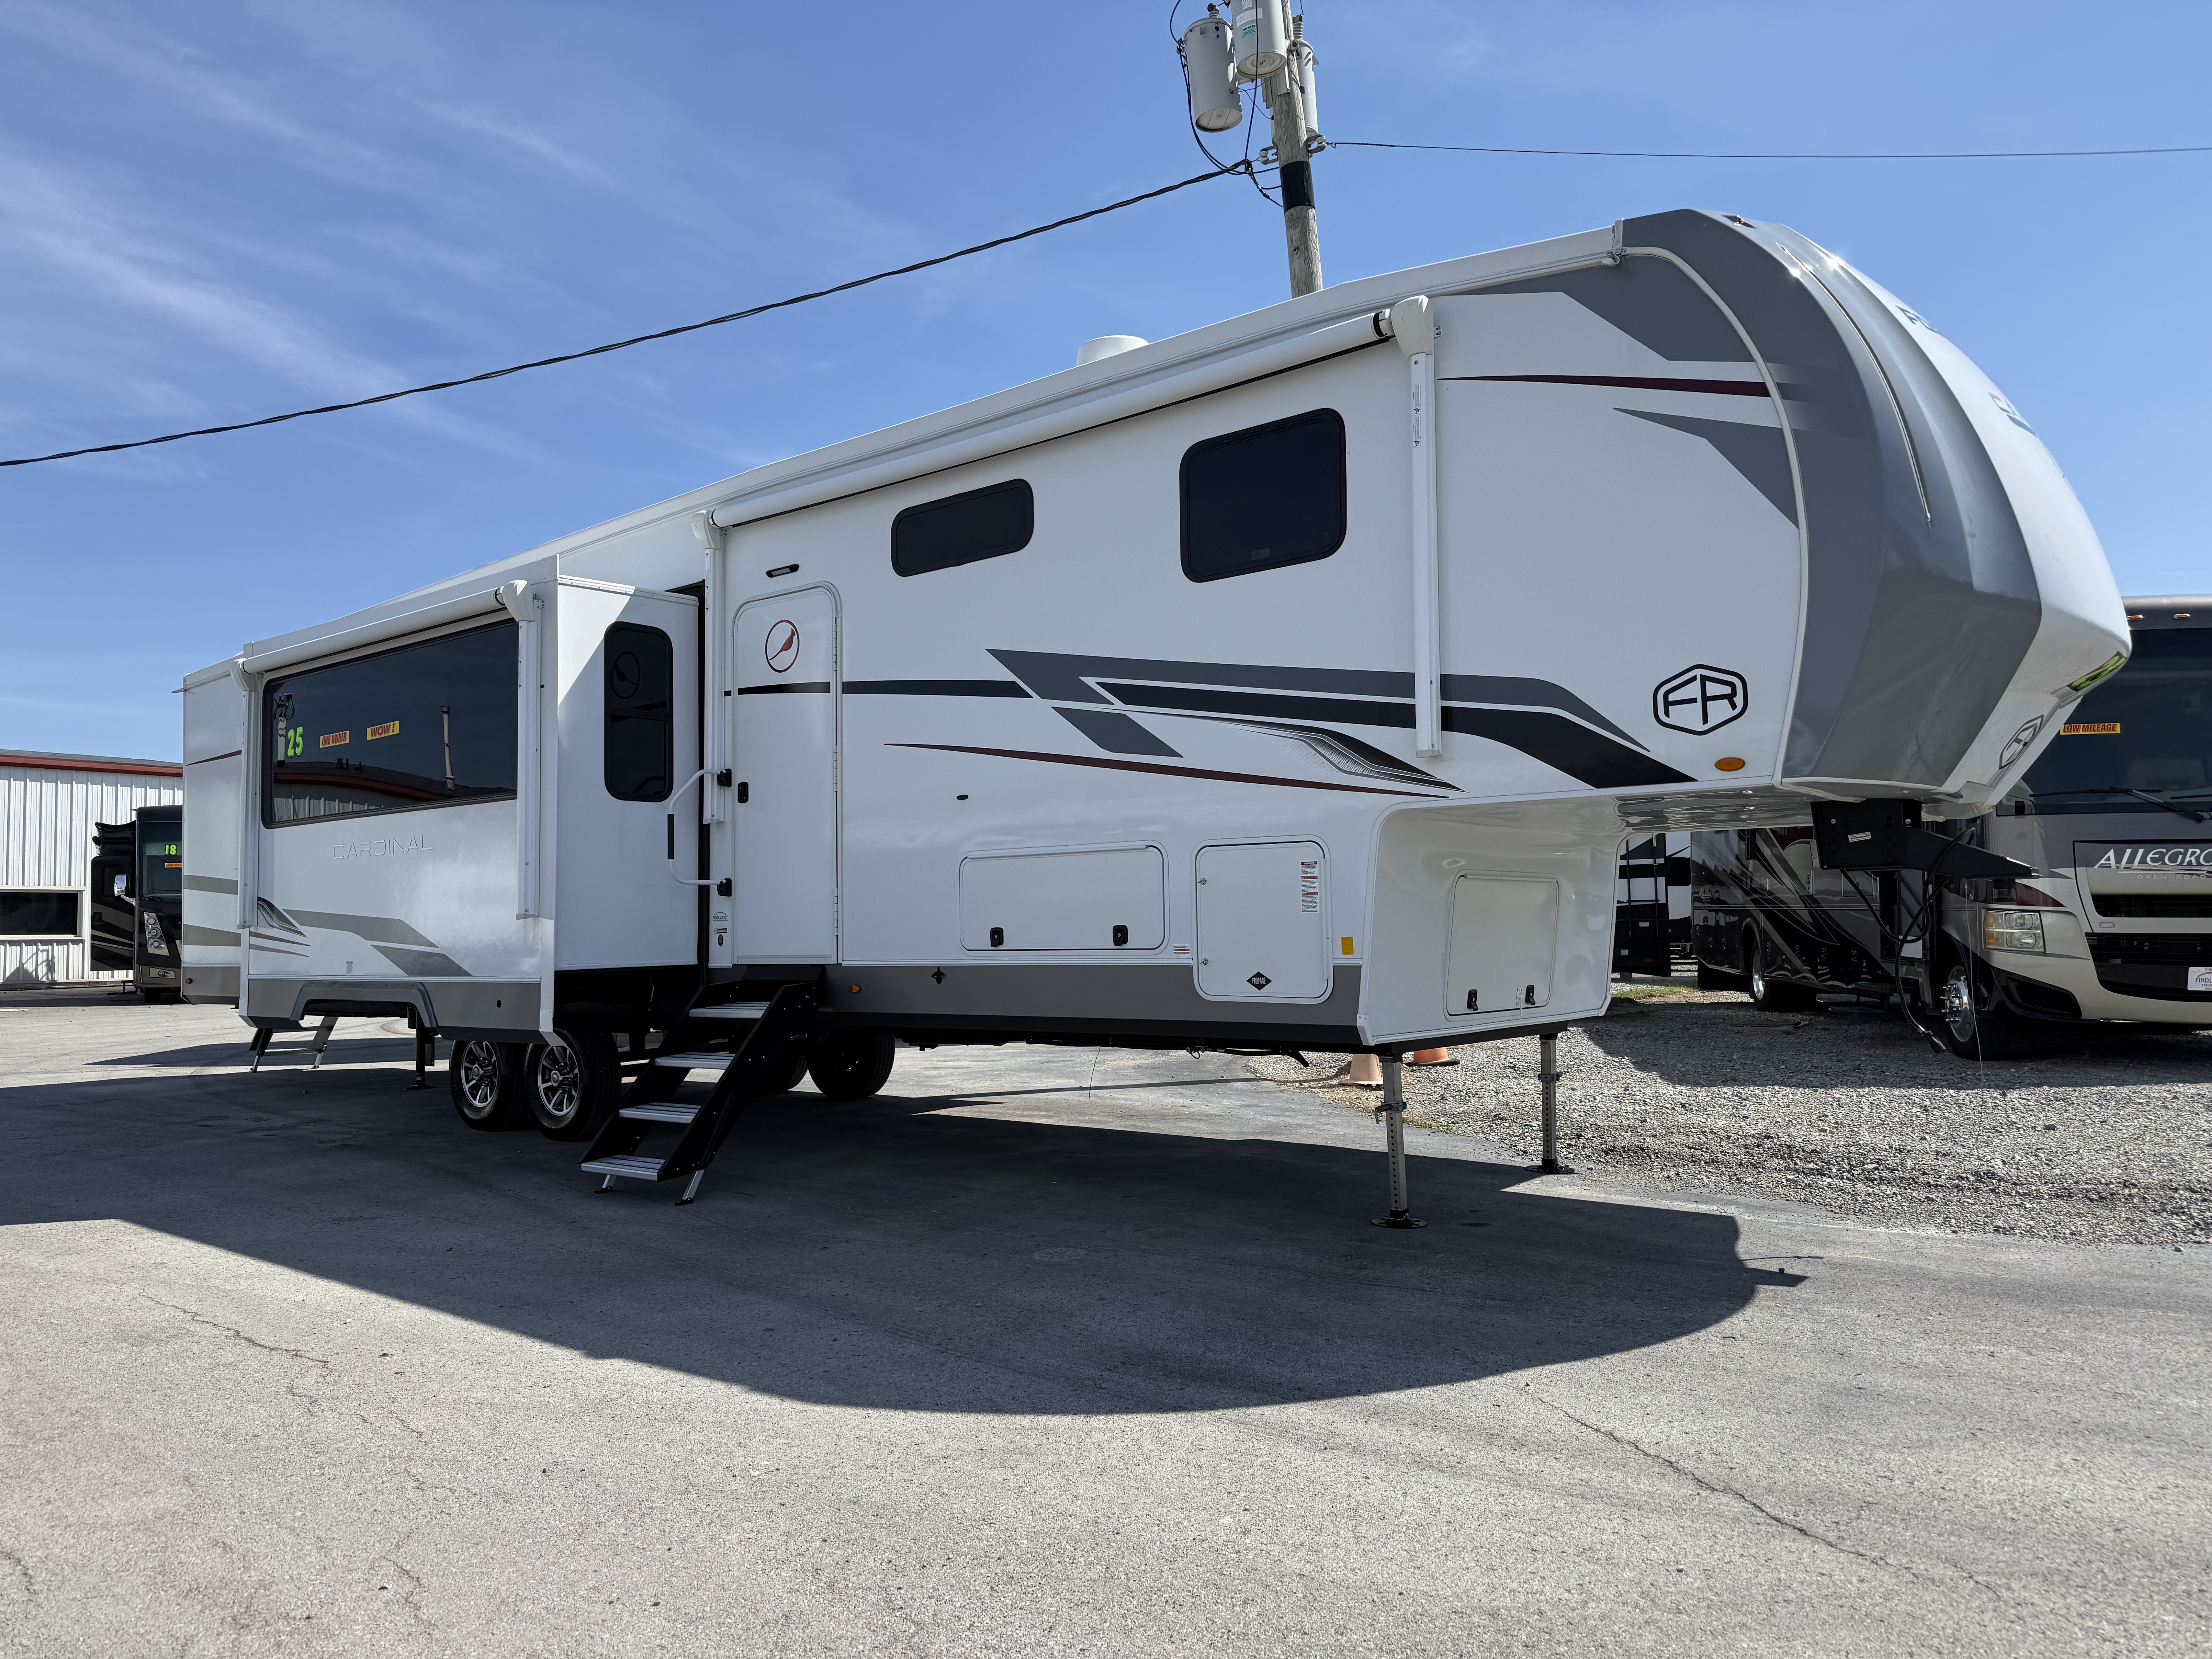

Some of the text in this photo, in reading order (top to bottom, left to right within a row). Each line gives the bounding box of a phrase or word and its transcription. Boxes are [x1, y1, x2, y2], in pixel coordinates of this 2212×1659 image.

[2063, 723, 2118, 733] LOW MILEAGE
[288, 727, 304, 757] 25
[165, 844, 177, 855] 18
[333, 835, 434, 859] CARDINAL
